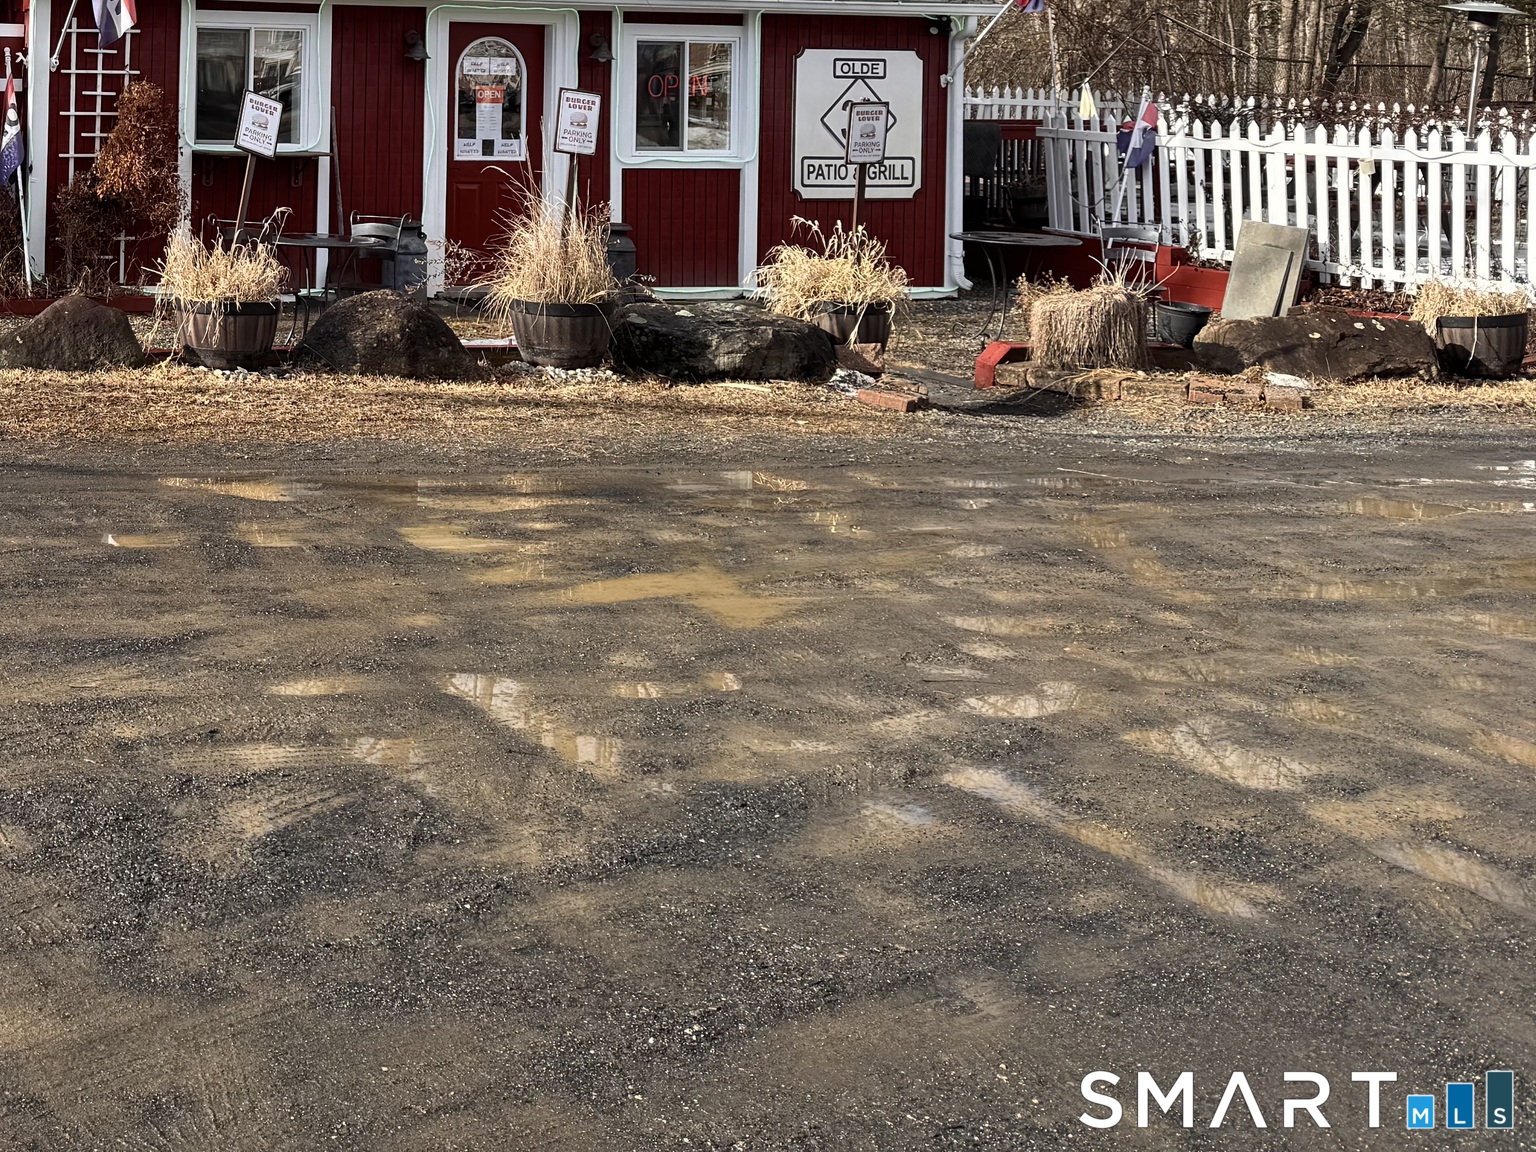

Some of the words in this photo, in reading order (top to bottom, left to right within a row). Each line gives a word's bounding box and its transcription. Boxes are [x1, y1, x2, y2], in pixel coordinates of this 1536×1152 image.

[840, 62, 880, 75] OLDE
[648, 74, 709, 98] OPN
[477, 90, 501, 99] OPEN
[249, 98, 278, 112] BURGER
[565, 96, 596, 106] BURGER
[251, 104, 275, 116] LOVER
[568, 103, 593, 111] LOVER
[245, 127, 273, 141] PARKING
[249, 134, 266, 145] ONLY
[563, 129, 593, 139] PARKING
[568, 136, 587, 144] ONLY
[806, 163, 849, 181] PATIO
[867, 163, 909, 181] GRILL
